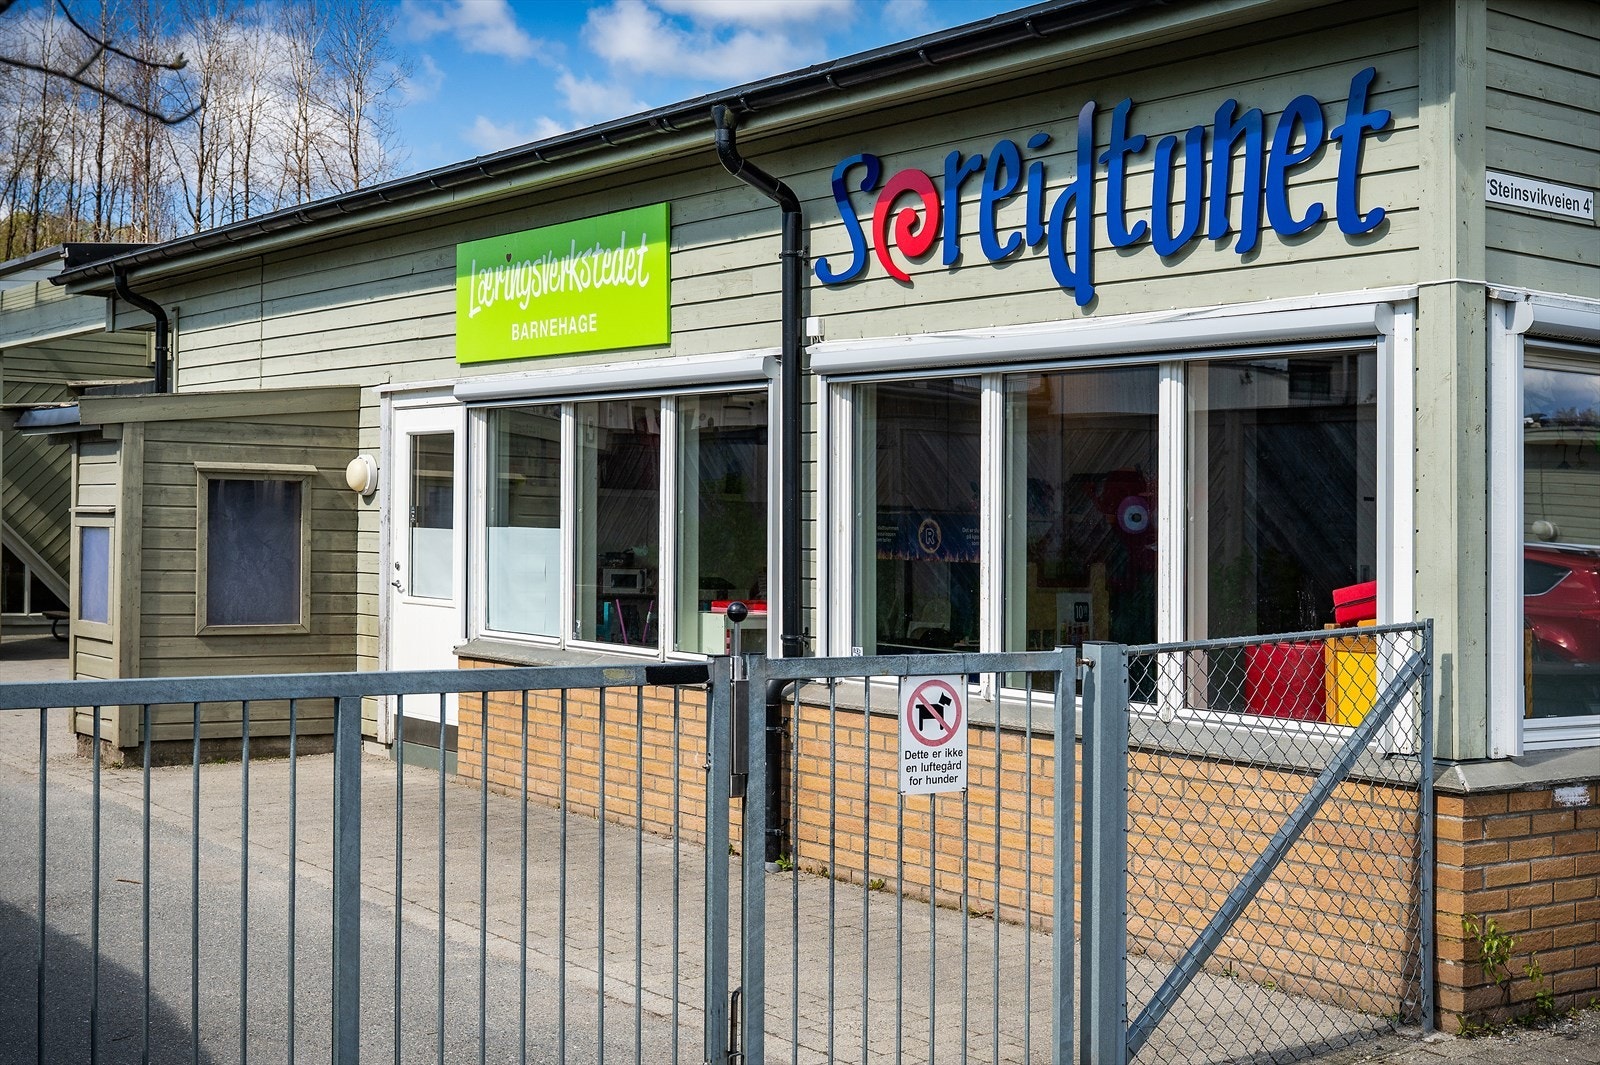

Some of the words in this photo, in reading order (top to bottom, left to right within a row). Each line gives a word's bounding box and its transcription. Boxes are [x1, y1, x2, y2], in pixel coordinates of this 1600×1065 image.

[1583, 198, 1590, 213] 4
[511, 313, 598, 341] BARNEHAGE
[905, 750, 929, 760] Dette
[932, 750, 942, 758] er
[945, 747, 963, 757] ikke
[921, 761, 962, 773] luftegård
[909, 775, 922, 785] for
[925, 774, 958, 784] hunder
